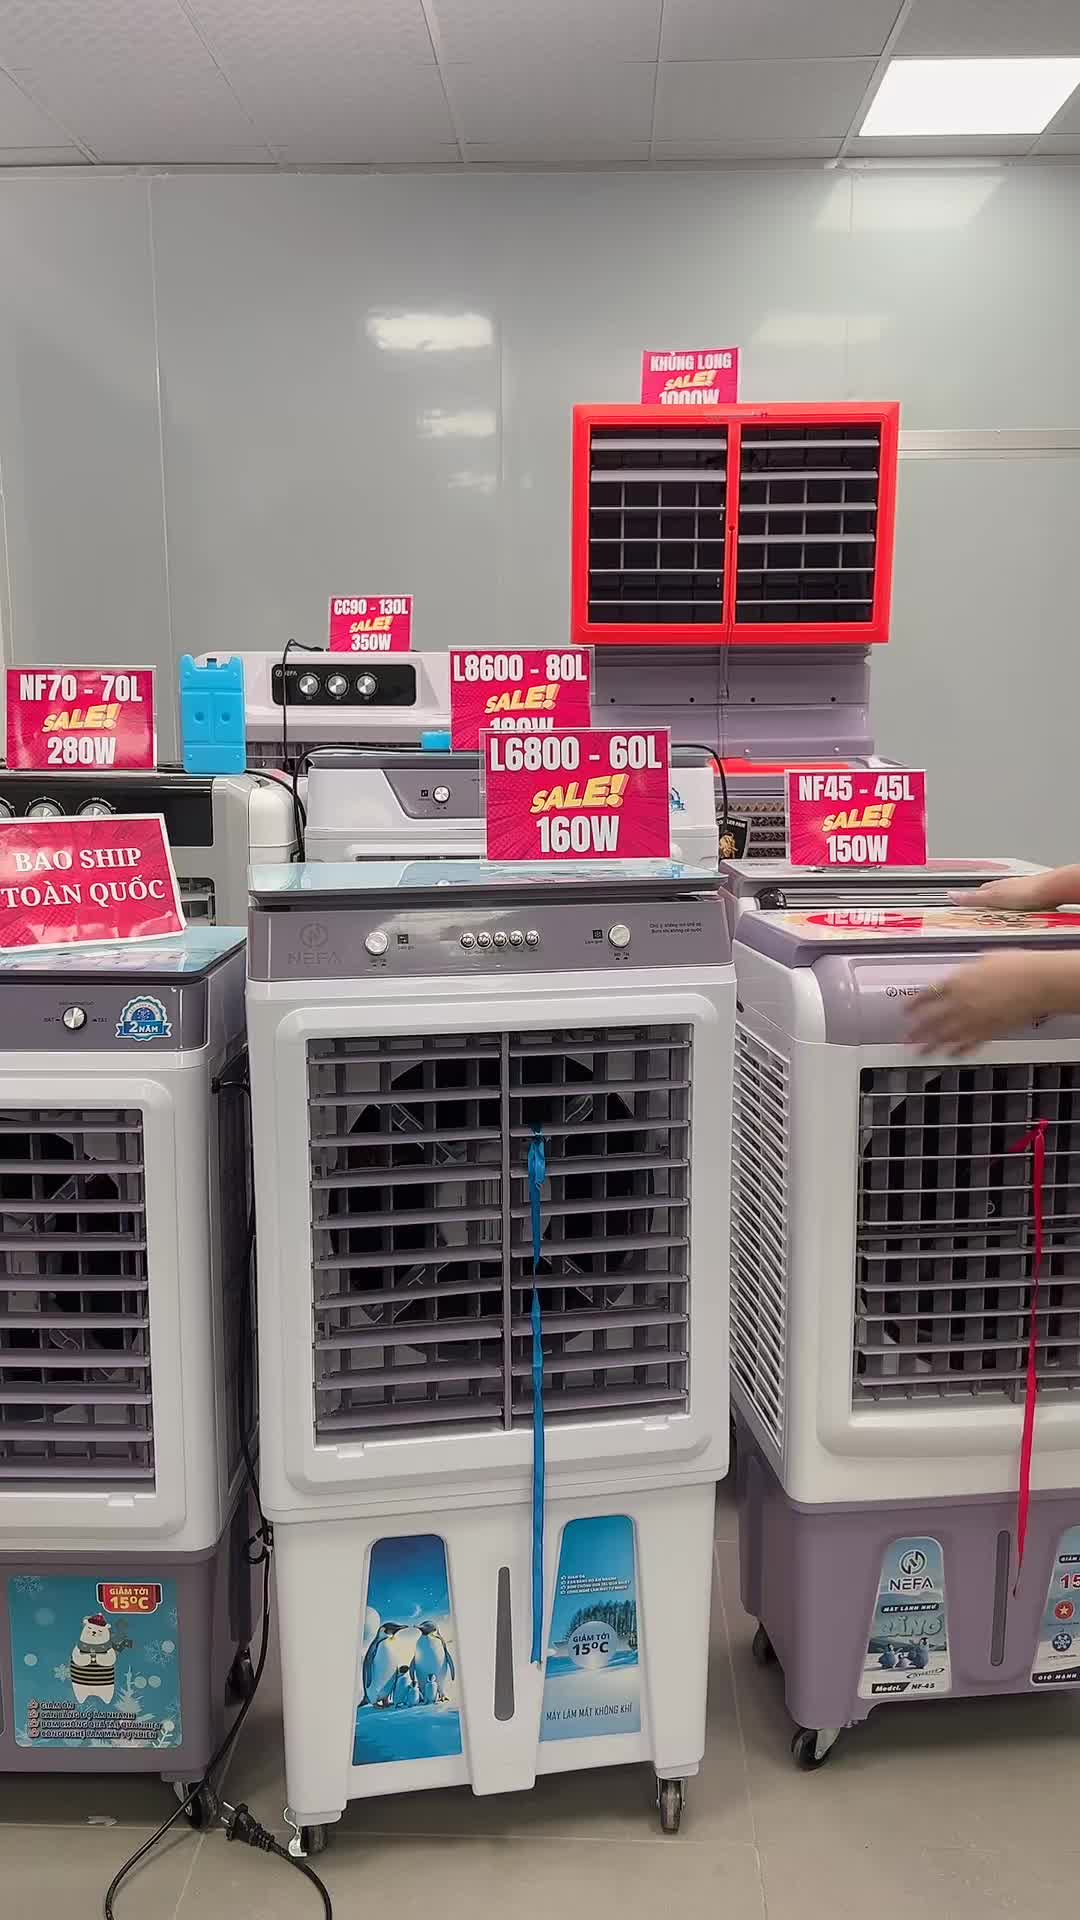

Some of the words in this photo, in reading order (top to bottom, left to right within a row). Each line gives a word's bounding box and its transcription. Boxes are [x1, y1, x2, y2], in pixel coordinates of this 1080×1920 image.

[650, 351, 695, 372] KHỦNG
[697, 352, 732, 370] LONG
[663, 369, 717, 391] SALE!
[659, 388, 720, 405] 1000W
[334, 599, 368, 616] CC90
[378, 598, 409, 615] 130L
[349, 615, 394, 634] SALE!
[351, 633, 392, 651] 350W
[453, 654, 524, 682] L8600
[546, 654, 588, 681] 80L
[19, 674, 77, 701] NF70
[100, 675, 143, 702] 70L
[484, 683, 561, 714] SALE!
[41, 703, 122, 733] SALE!
[47, 736, 117, 765] 280W
[490, 737, 580, 771] L6800
[609, 735, 662, 769] 60L
[529, 773, 630, 814] SALE!
[799, 775, 853, 801] NF45
[874, 775, 915, 801] 45L
[821, 803, 897, 832] SALE!
[536, 815, 620, 853] 160W
[13, 850, 73, 872] BAO
[79, 847, 142, 869] SHIP
[826, 834, 889, 863] 150W
[1, 880, 82, 908] TOÀN
[89, 874, 166, 907] QUỐC
[128, 1021, 139, 1033] 2
[109, 1586, 132, 1595] GIẢM
[134, 1586, 149, 1595] TỚI
[889, 1578, 933, 1591] NEFA
[572, 1632, 594, 1643] GIẢM
[596, 1632, 610, 1641] TỚI
